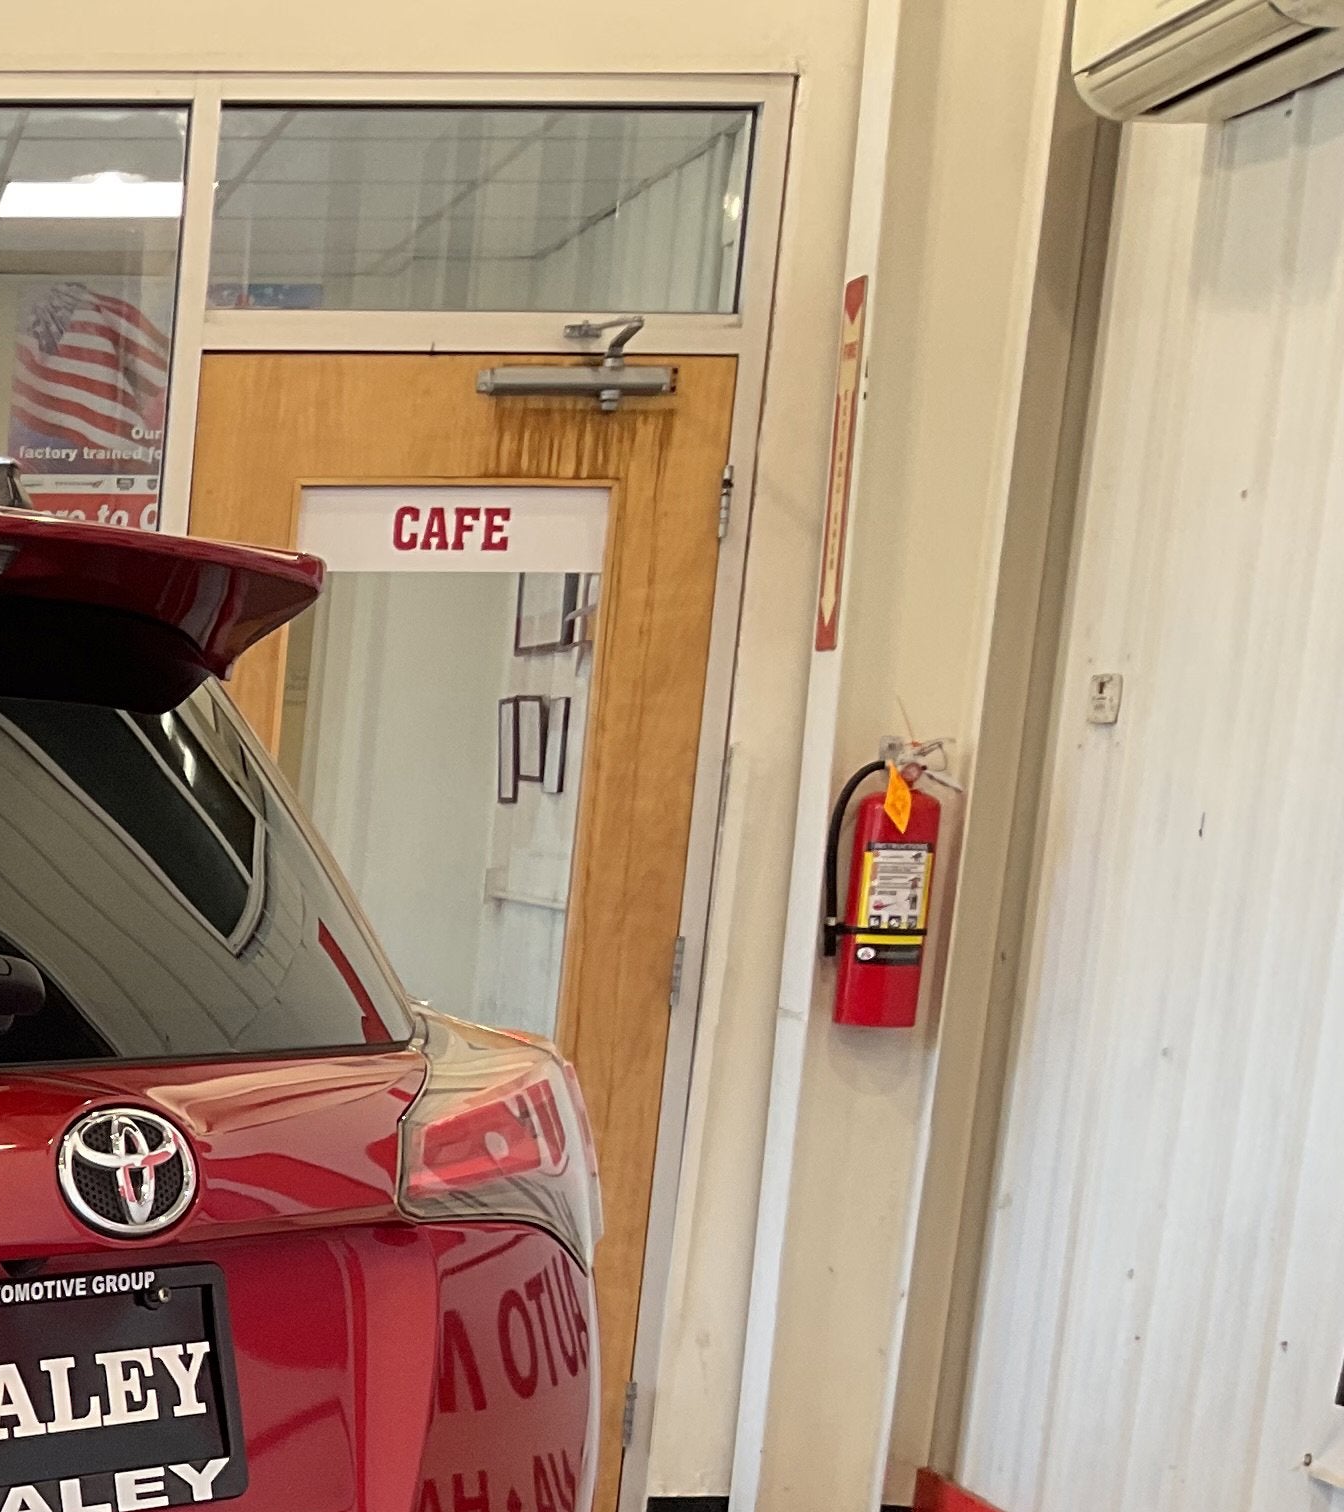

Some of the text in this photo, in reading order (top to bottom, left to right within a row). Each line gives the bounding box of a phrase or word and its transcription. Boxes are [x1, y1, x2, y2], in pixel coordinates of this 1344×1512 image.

[19, 445, 161, 464] factory trained fo
[393, 505, 512, 551] CAFE
[92, 1271, 156, 1295] GROUP
